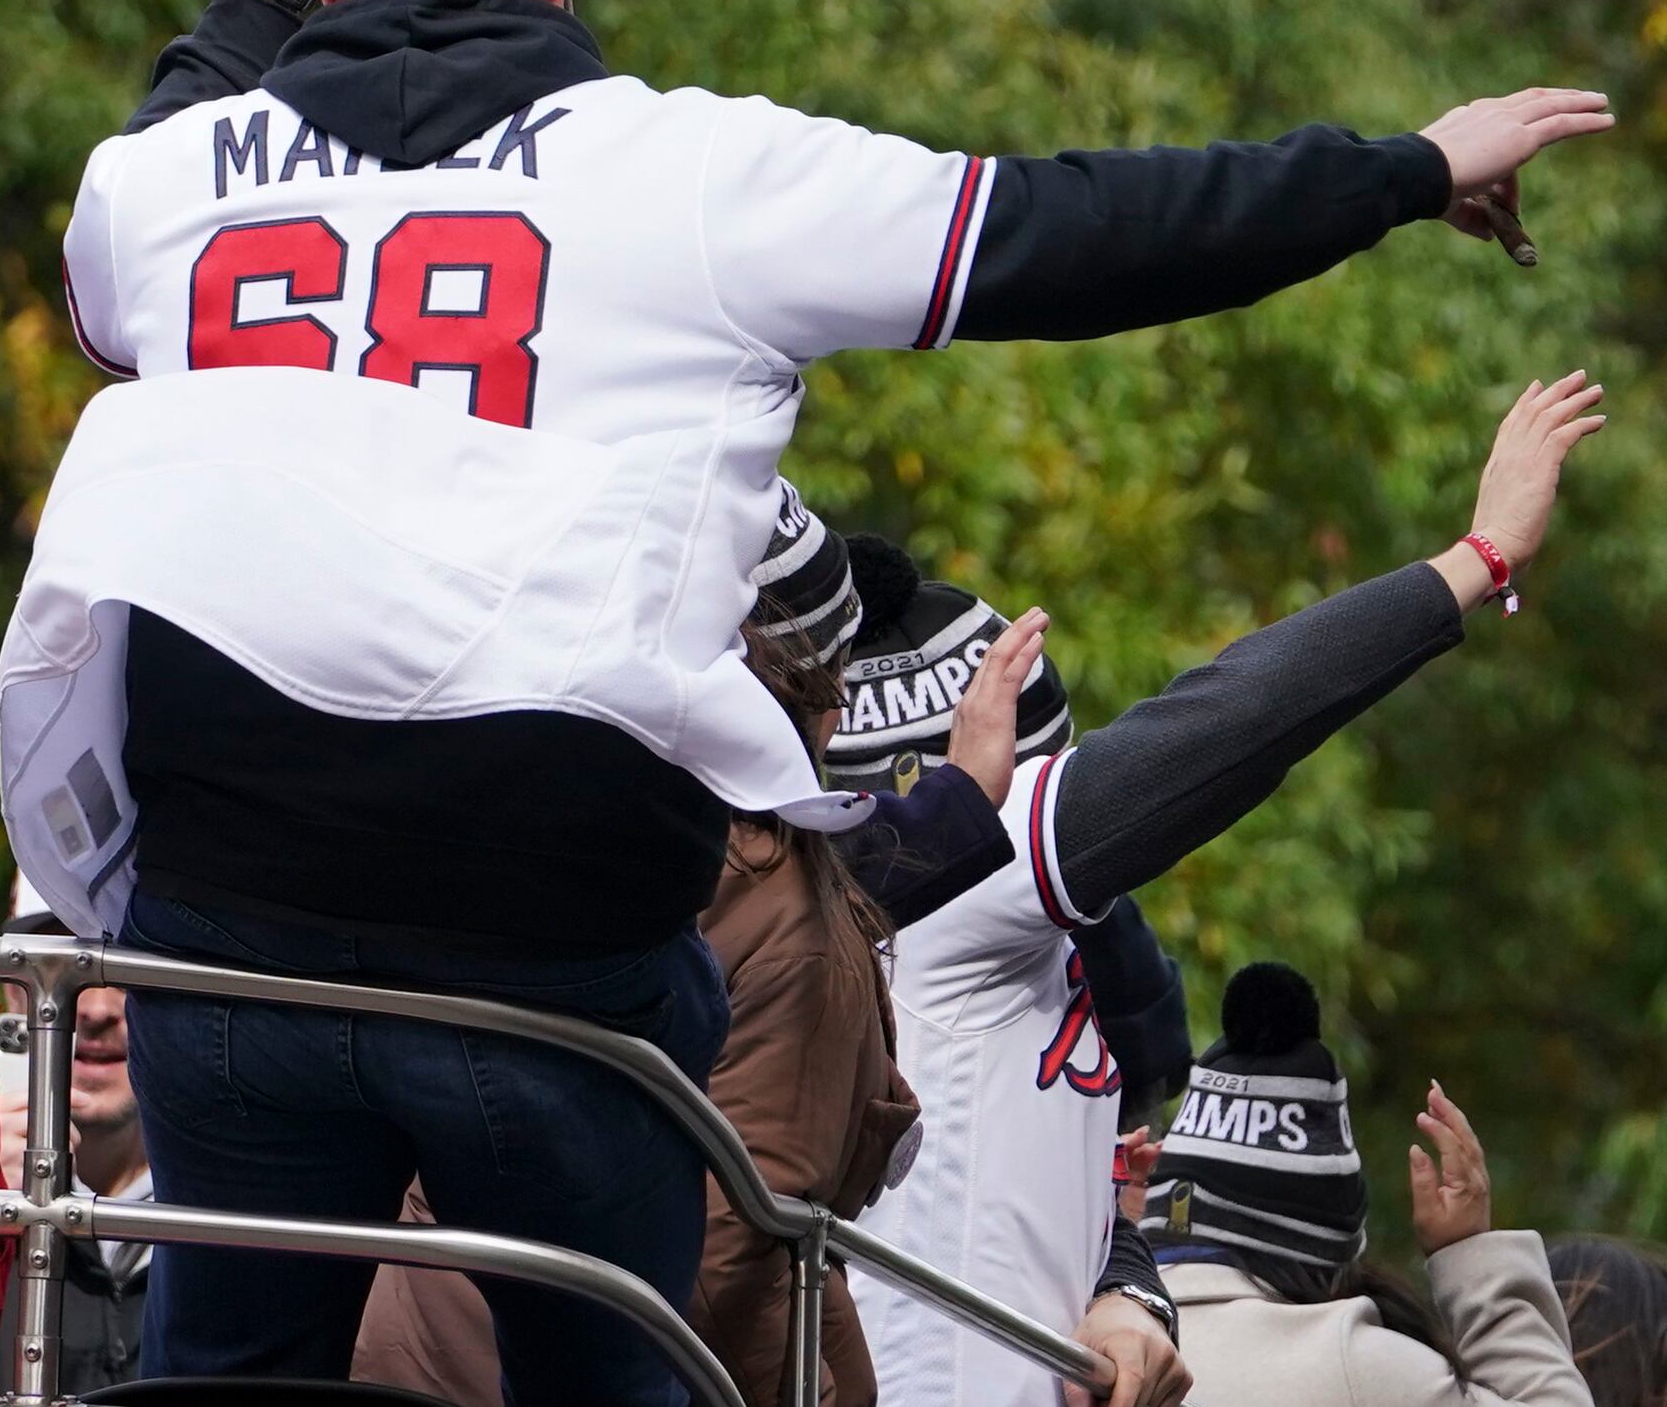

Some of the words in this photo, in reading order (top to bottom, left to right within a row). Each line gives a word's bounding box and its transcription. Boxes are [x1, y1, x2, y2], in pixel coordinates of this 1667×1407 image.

[214, 102, 573, 200] MAK
[187, 210, 552, 430] 68
[861, 653, 925, 677] 2021
[1199, 1072, 1250, 1092] 2021
